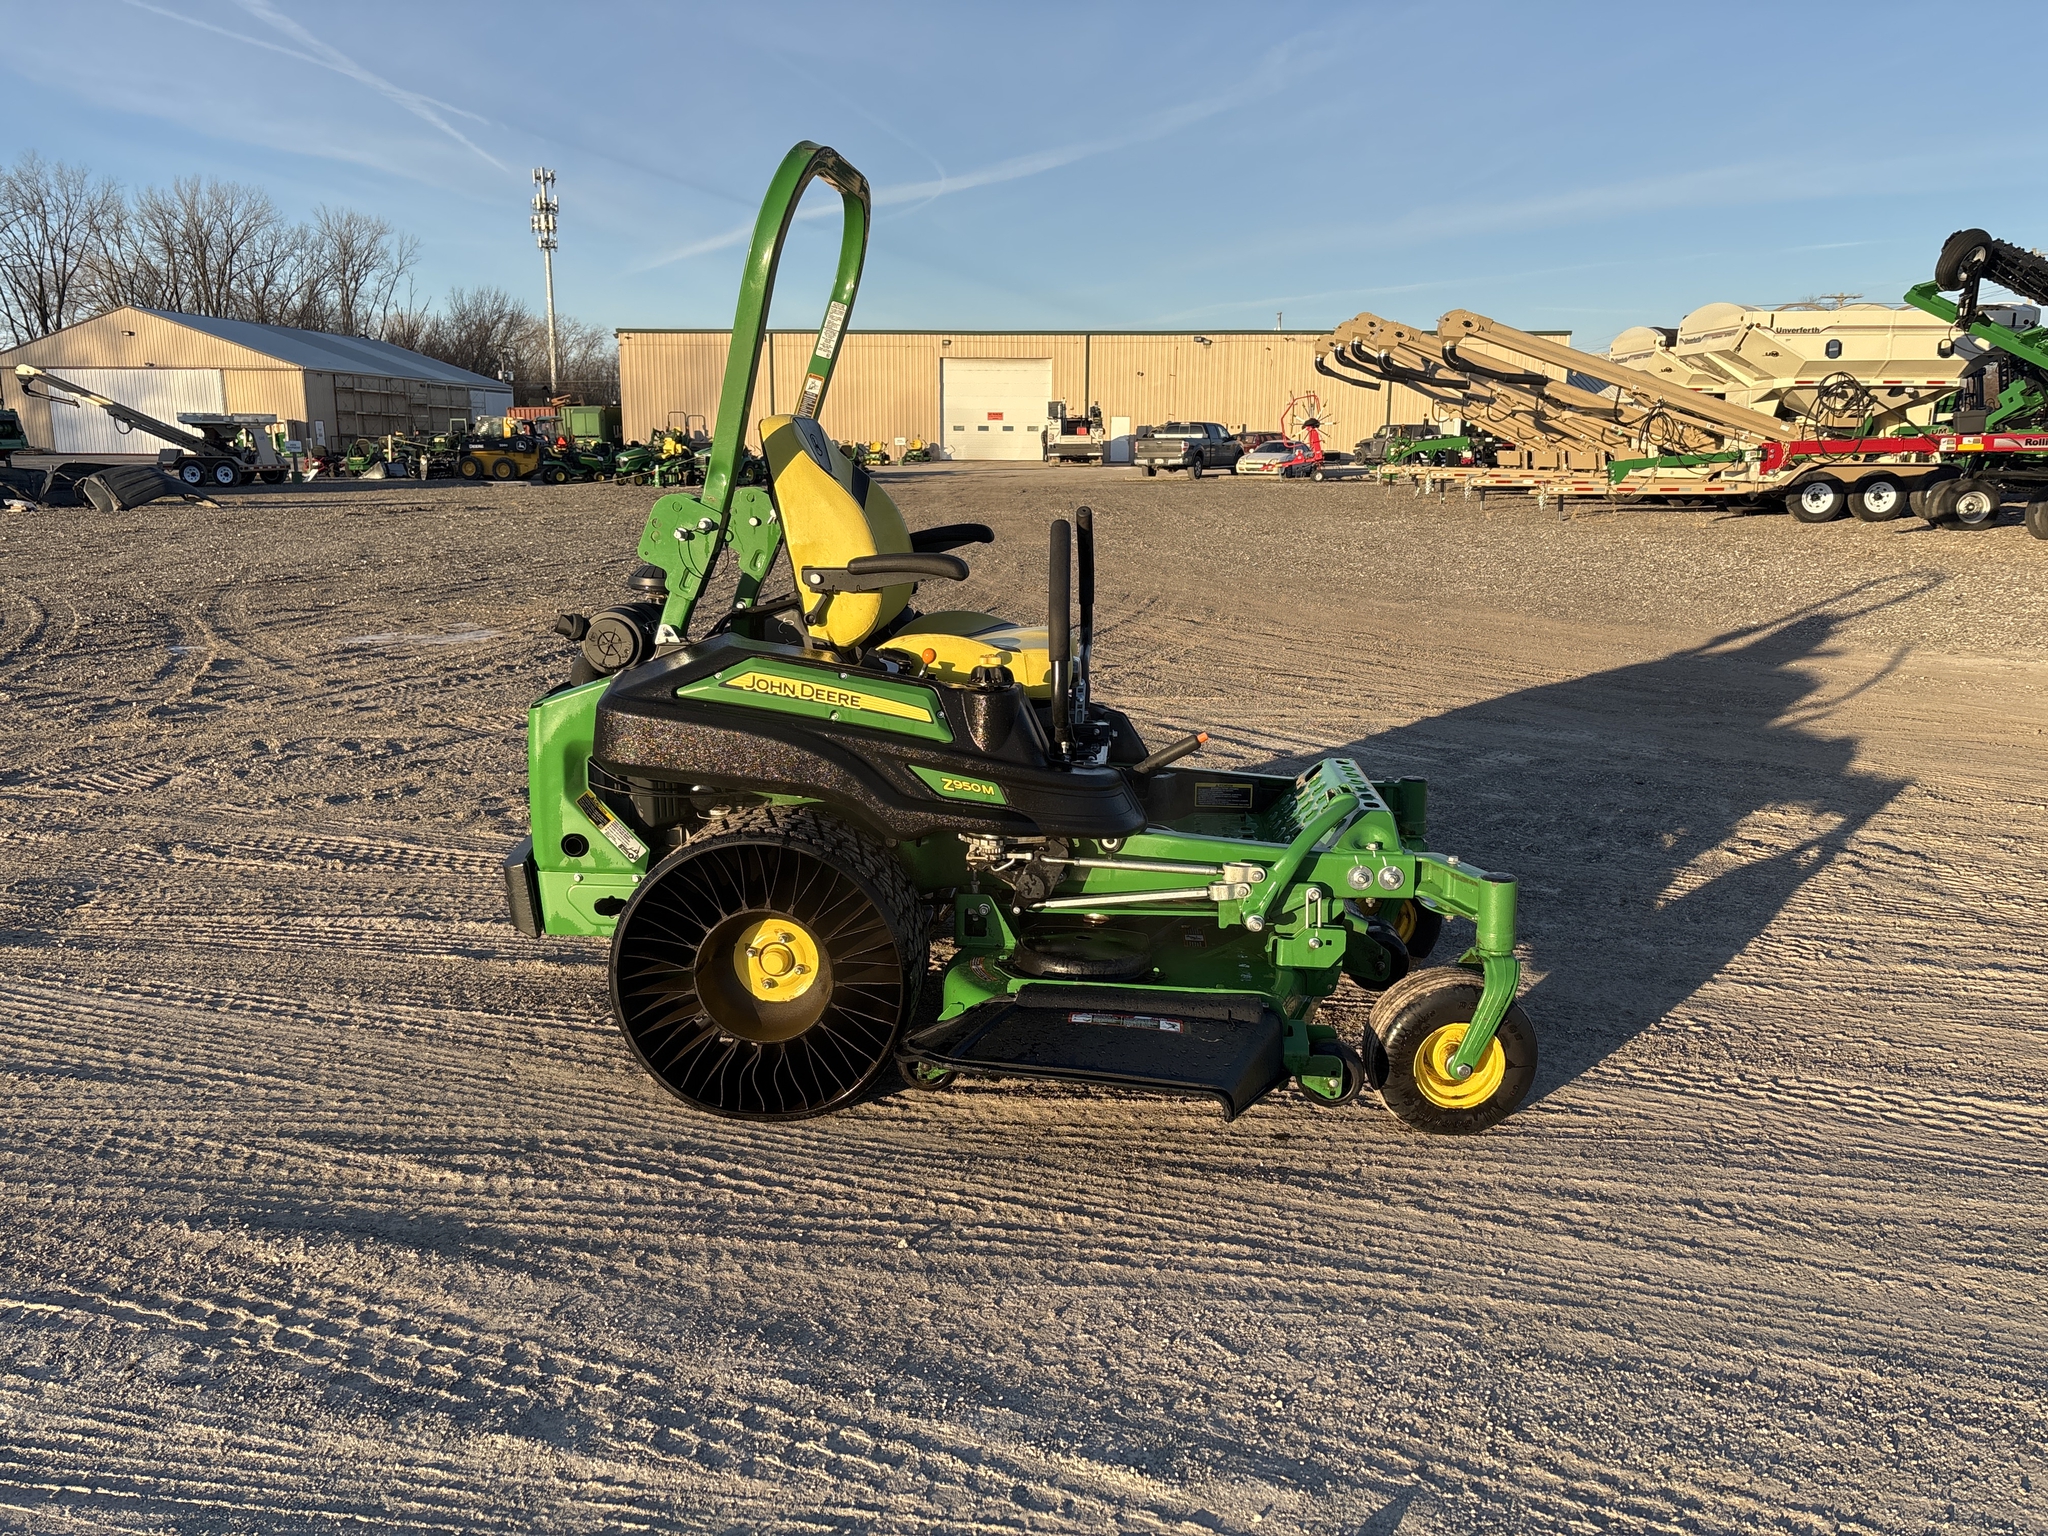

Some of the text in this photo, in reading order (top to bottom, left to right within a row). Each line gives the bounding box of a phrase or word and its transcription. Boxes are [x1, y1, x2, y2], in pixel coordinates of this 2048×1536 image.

[1775, 326, 1820, 334] Unverferth
[745, 675, 861, 707] JOHN DEERE
[941, 777, 995, 795] Z950M
